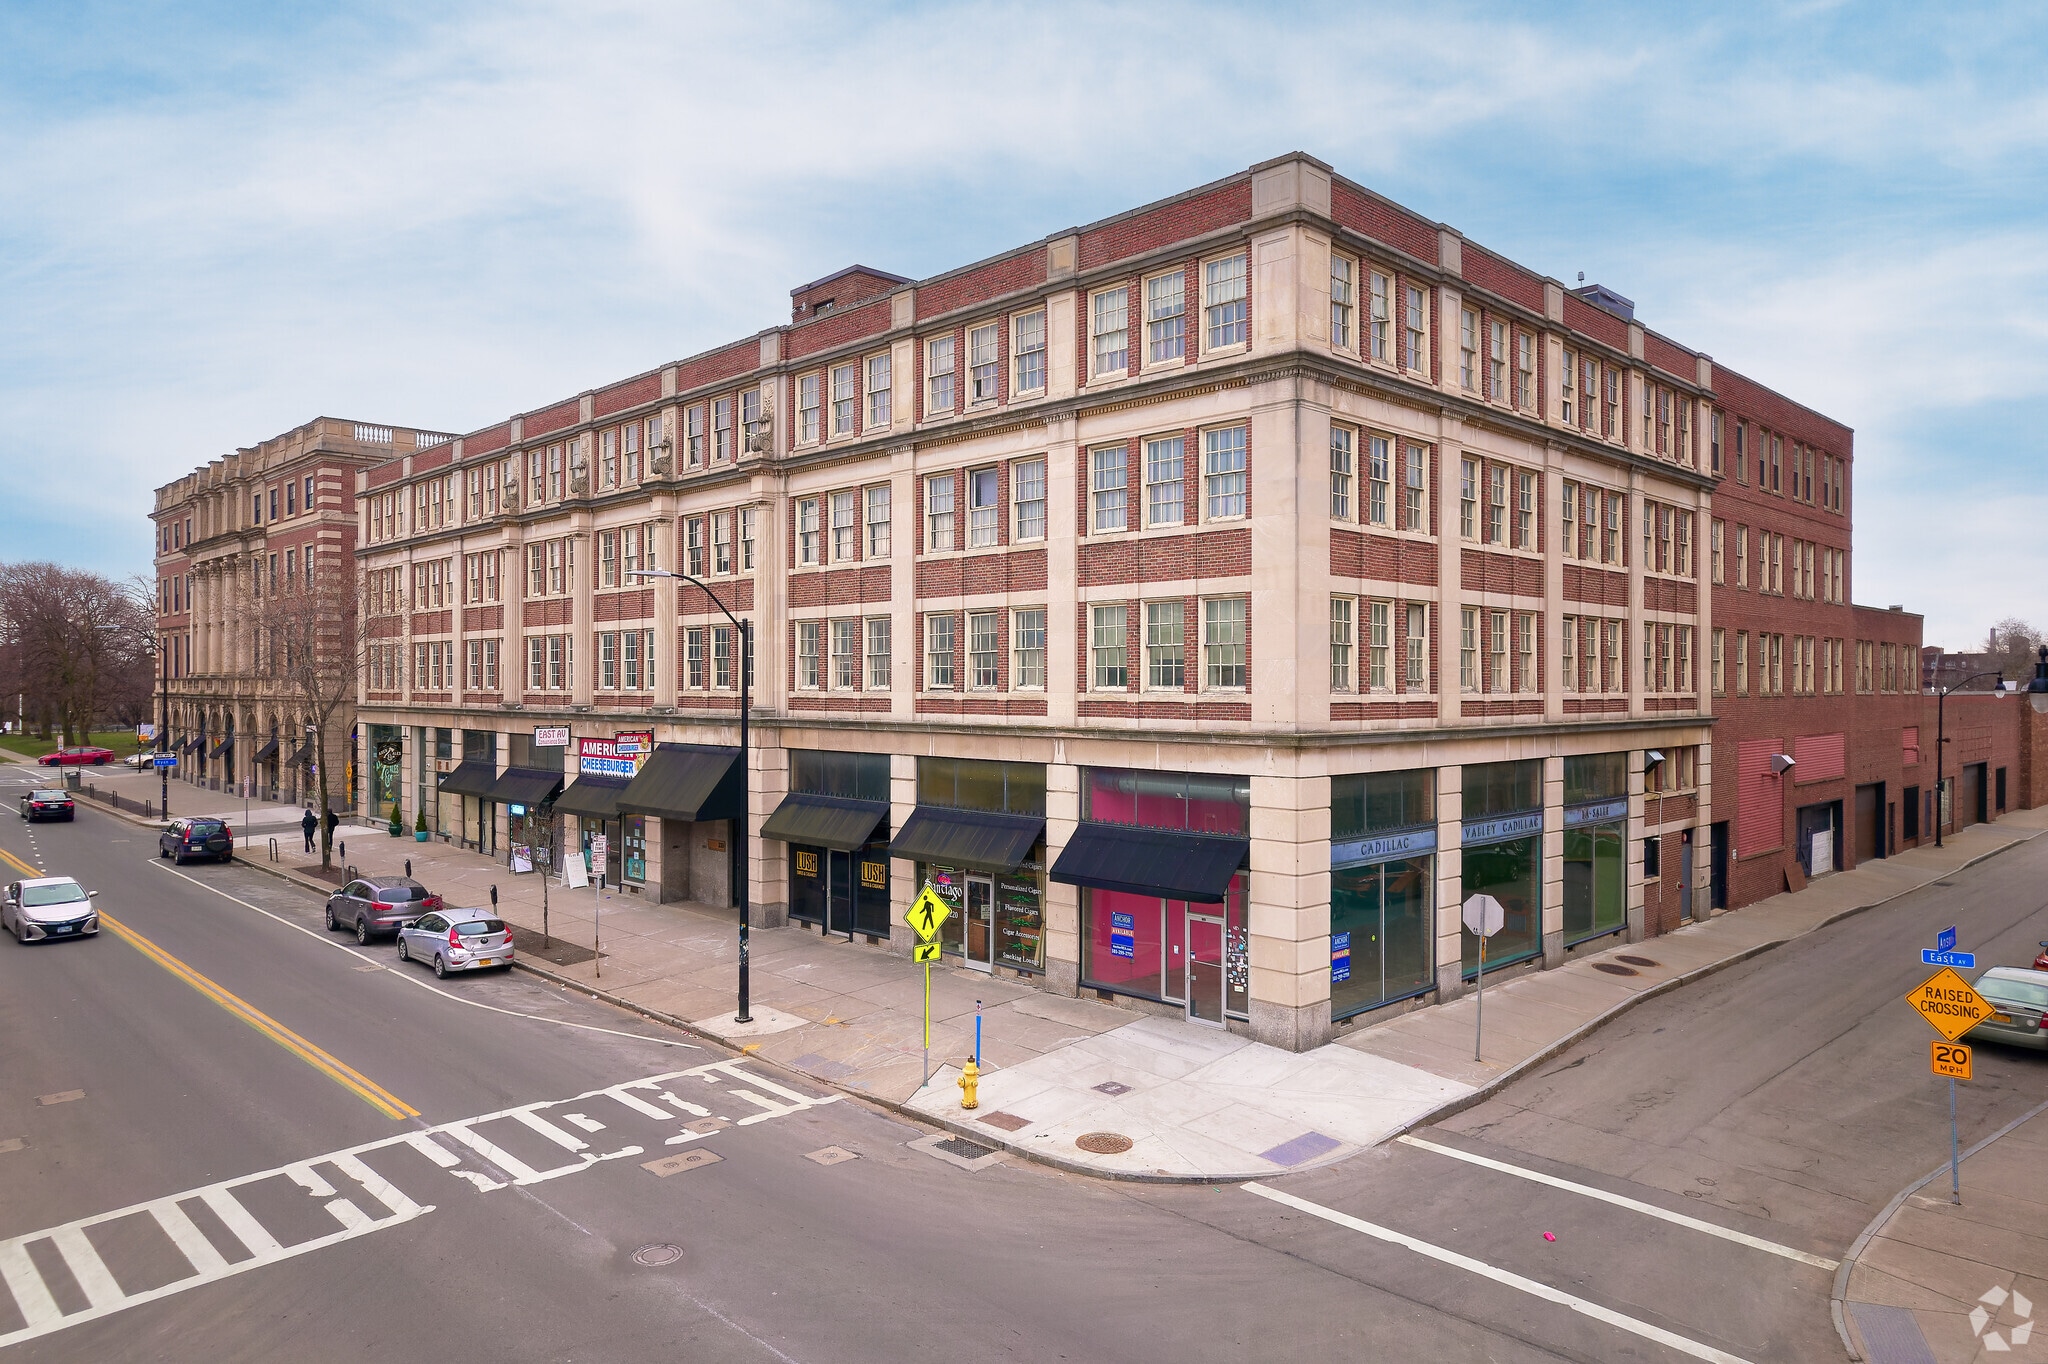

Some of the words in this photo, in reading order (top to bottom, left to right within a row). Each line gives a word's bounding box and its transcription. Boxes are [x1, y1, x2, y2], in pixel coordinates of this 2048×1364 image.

[538, 730, 556, 738] EAST
[556, 729, 566, 738] AV
[582, 742, 634, 758] AMERIC
[582, 758, 634, 773] CHEESEBURGER
[1465, 824, 1497, 839] VALLEY
[1502, 817, 1539, 833] CADILLAC
[1360, 838, 1410, 856] CADILLAC
[798, 852, 816, 871] LUSH
[863, 863, 884, 882] LUSH
[1001, 883, 1027, 892] Personalized
[1028, 887, 1042, 895] Cigars
[1005, 904, 1024, 913] Flavored
[1115, 914, 1131, 923] ANCHOR
[1003, 928, 1015, 937] Cigar
[1015, 931, 1040, 940] Accessories
[1003, 952, 1021, 962] Smoking
[1023, 956, 1039, 966] Lounge
[1930, 953, 1954, 964] East
[1926, 987, 1973, 1003] RAISED
[1921, 1001, 1979, 1019] CROSSING
[1936, 1046, 1967, 1065] 20
[1940, 1064, 1963, 1074] MPH
